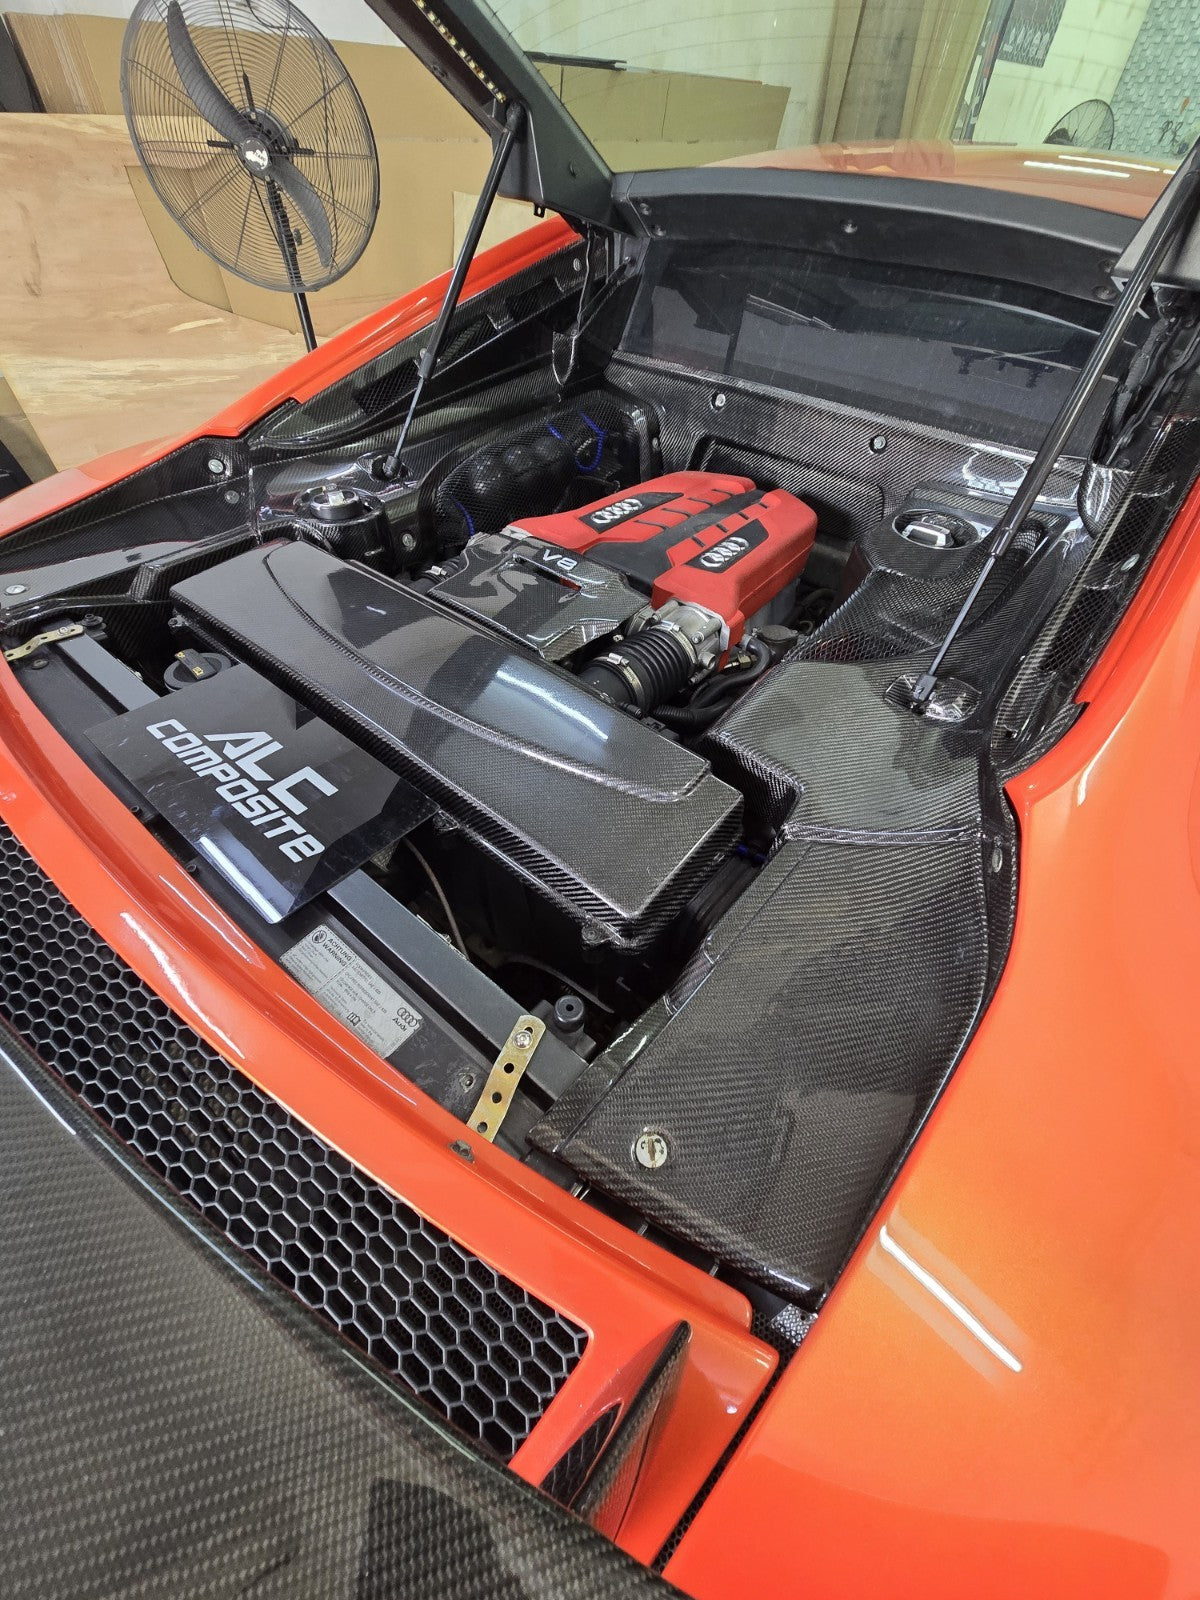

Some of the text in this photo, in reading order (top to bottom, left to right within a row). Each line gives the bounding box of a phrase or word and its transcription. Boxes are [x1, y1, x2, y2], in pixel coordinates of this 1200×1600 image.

[543, 549, 577, 570] V8
[203, 731, 339, 815] ALC
[146, 718, 325, 863] COMPOSITE
[322, 942, 347, 967] WARNING
[327, 938, 353, 961] ACHTUNG
[392, 1016, 408, 1032] Audi
